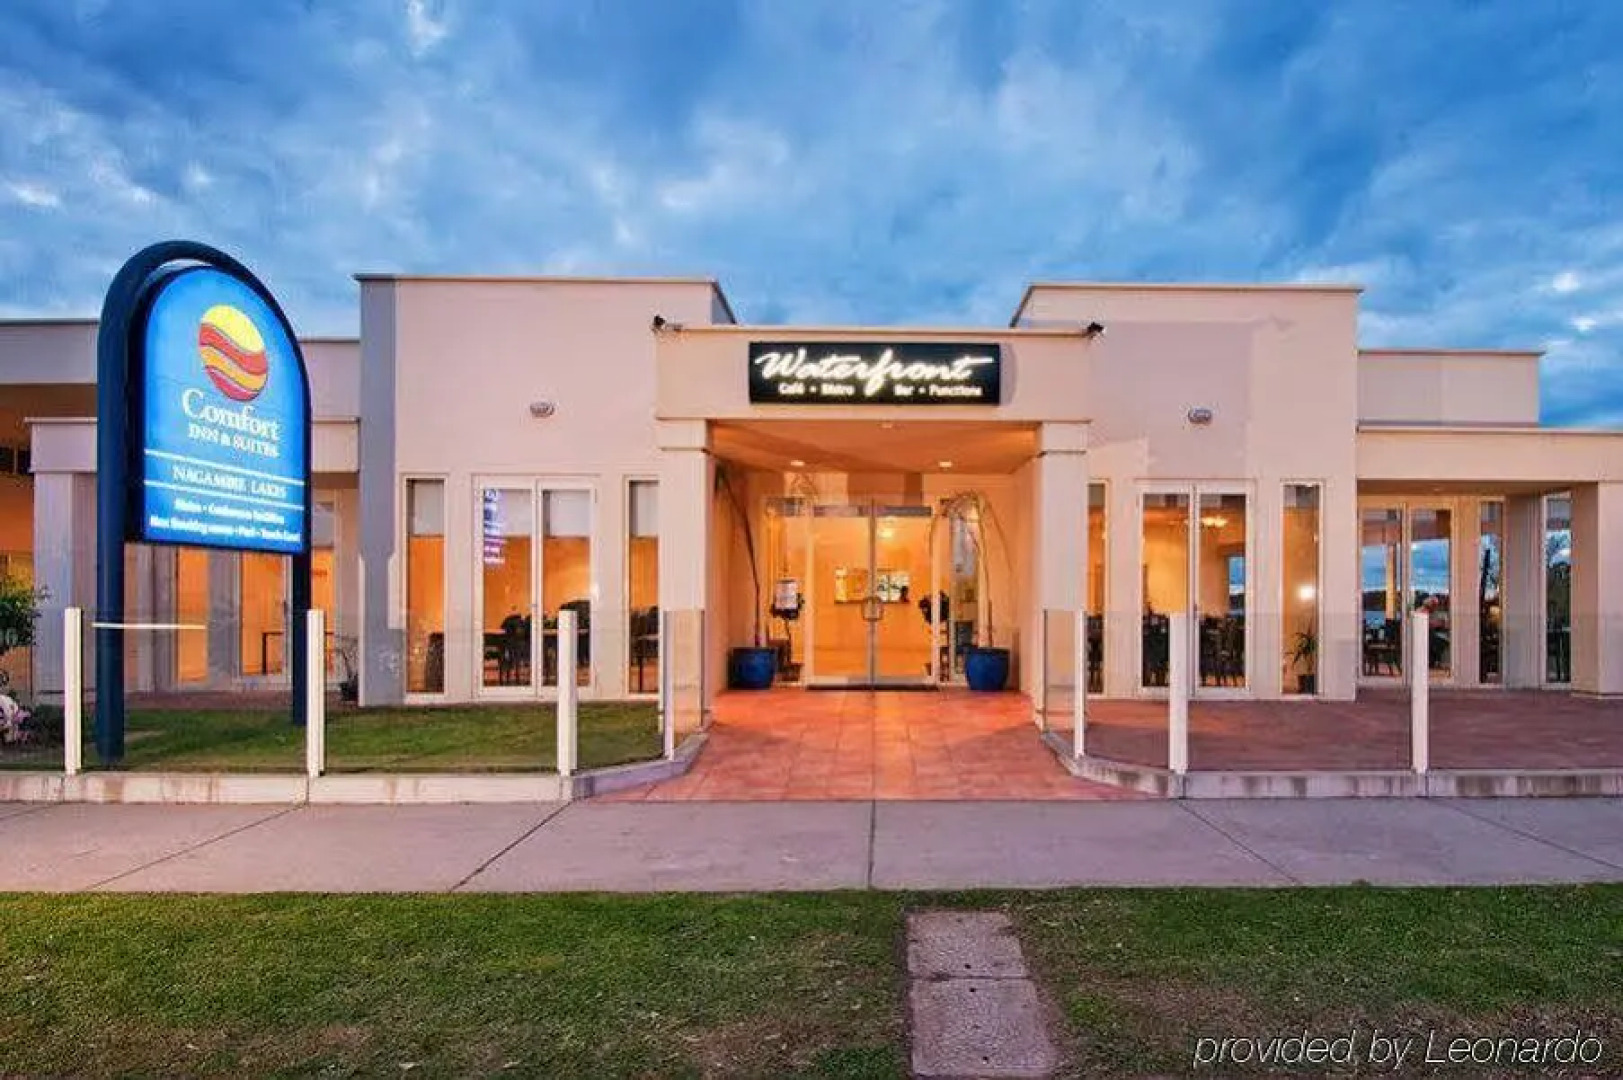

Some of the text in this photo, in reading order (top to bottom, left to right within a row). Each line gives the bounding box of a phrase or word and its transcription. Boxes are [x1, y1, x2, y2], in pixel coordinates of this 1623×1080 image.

[754, 348, 993, 397] Waterfront
[183, 388, 280, 441] Comfort
[188, 422, 280, 458] INN & SUITES
